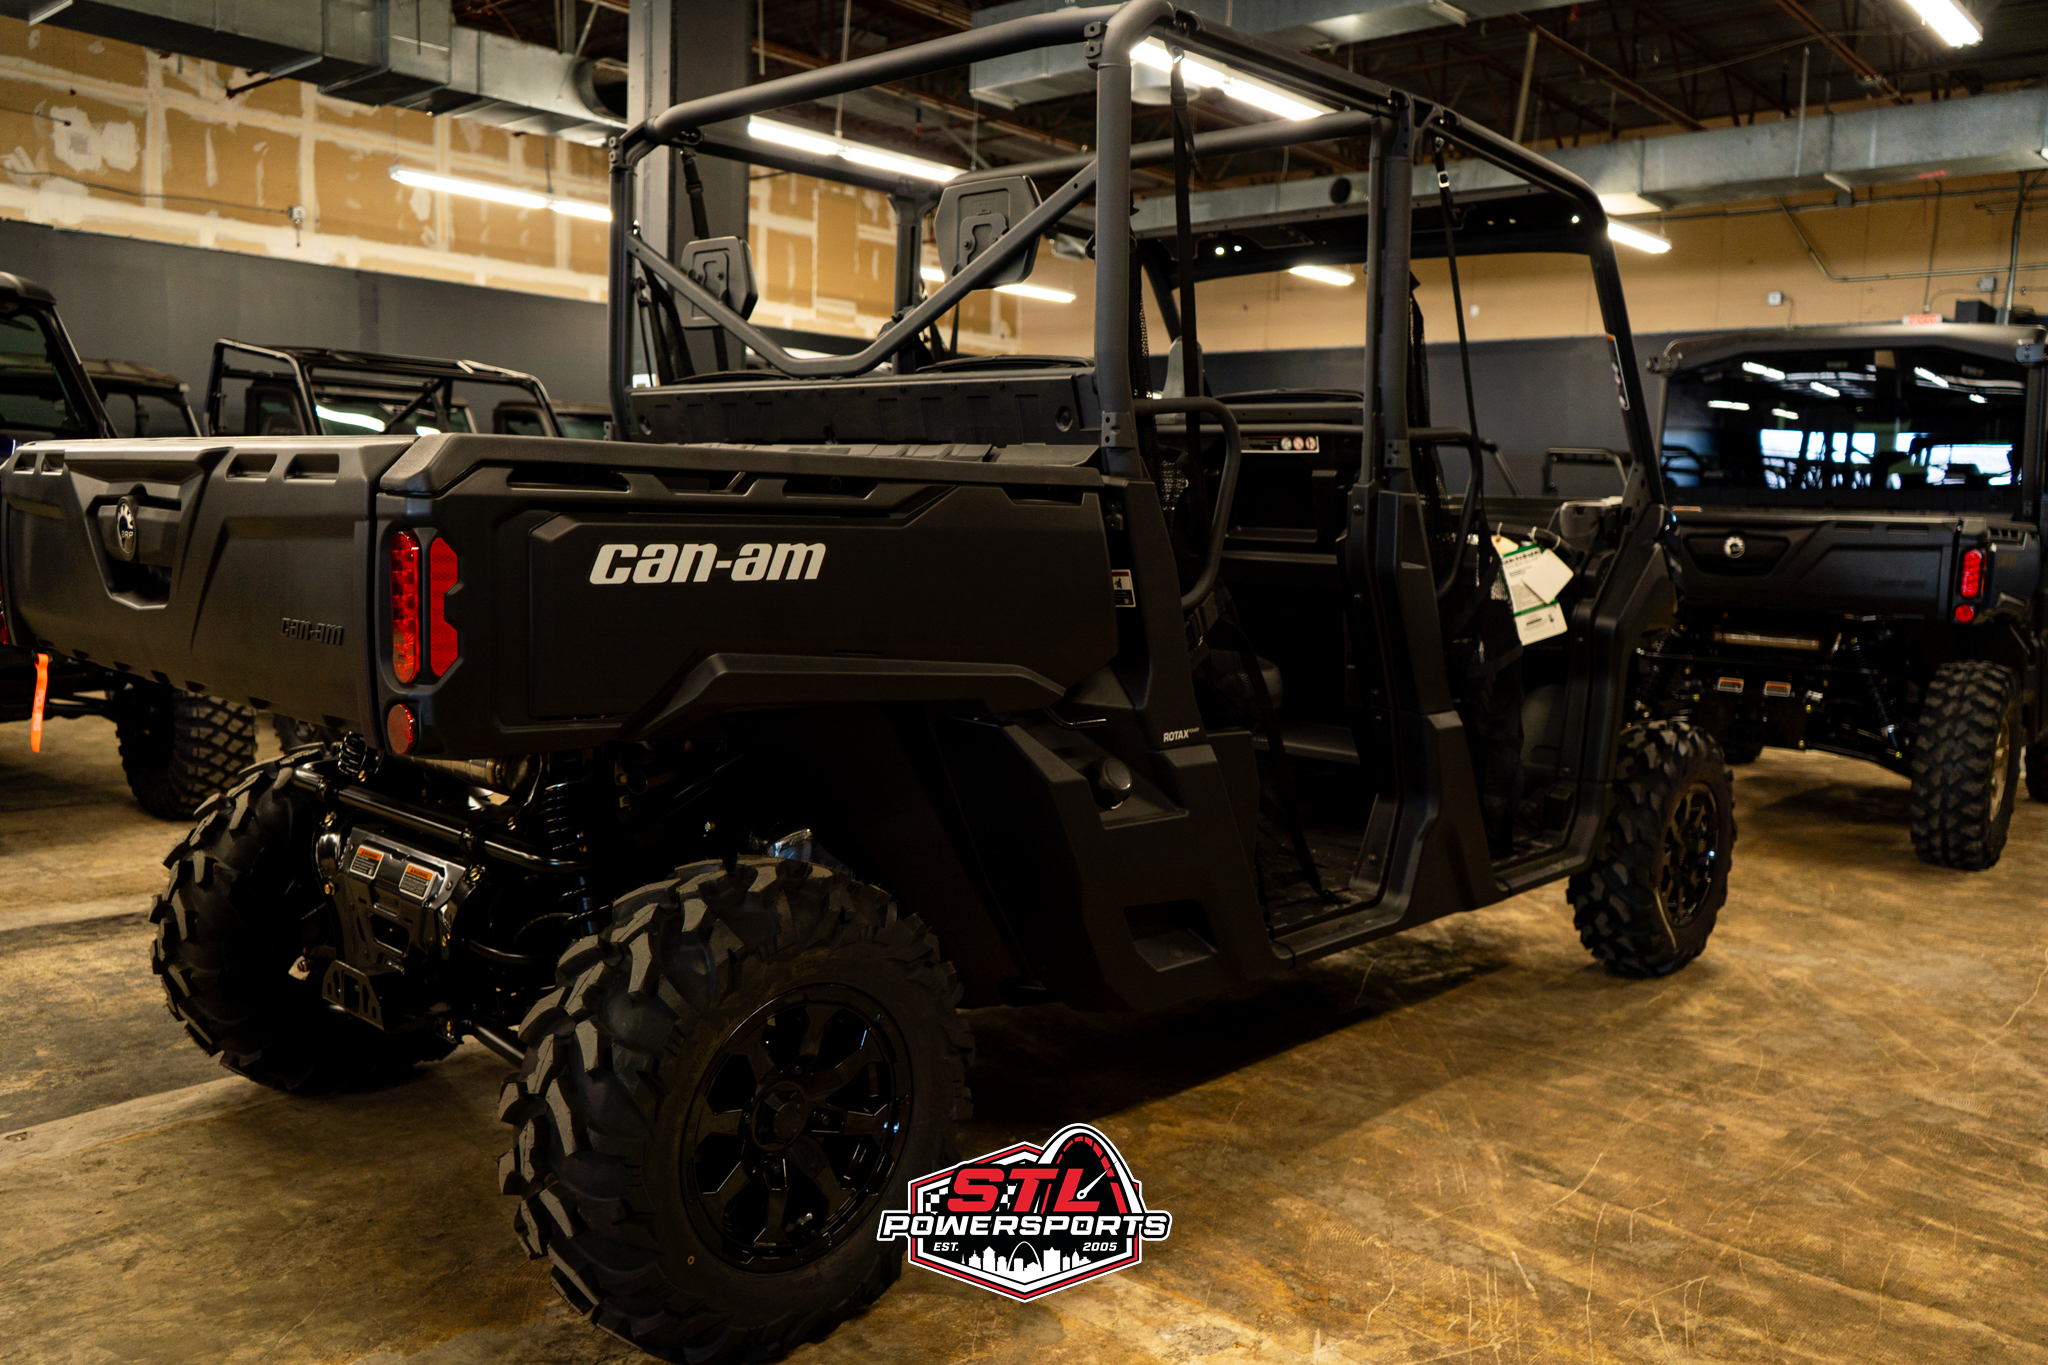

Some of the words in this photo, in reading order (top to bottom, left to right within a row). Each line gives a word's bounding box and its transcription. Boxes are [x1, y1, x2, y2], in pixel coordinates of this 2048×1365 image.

[589, 543, 827, 585] can-am
[281, 617, 344, 646] can-am
[1163, 729, 1189, 743] ROTAX
